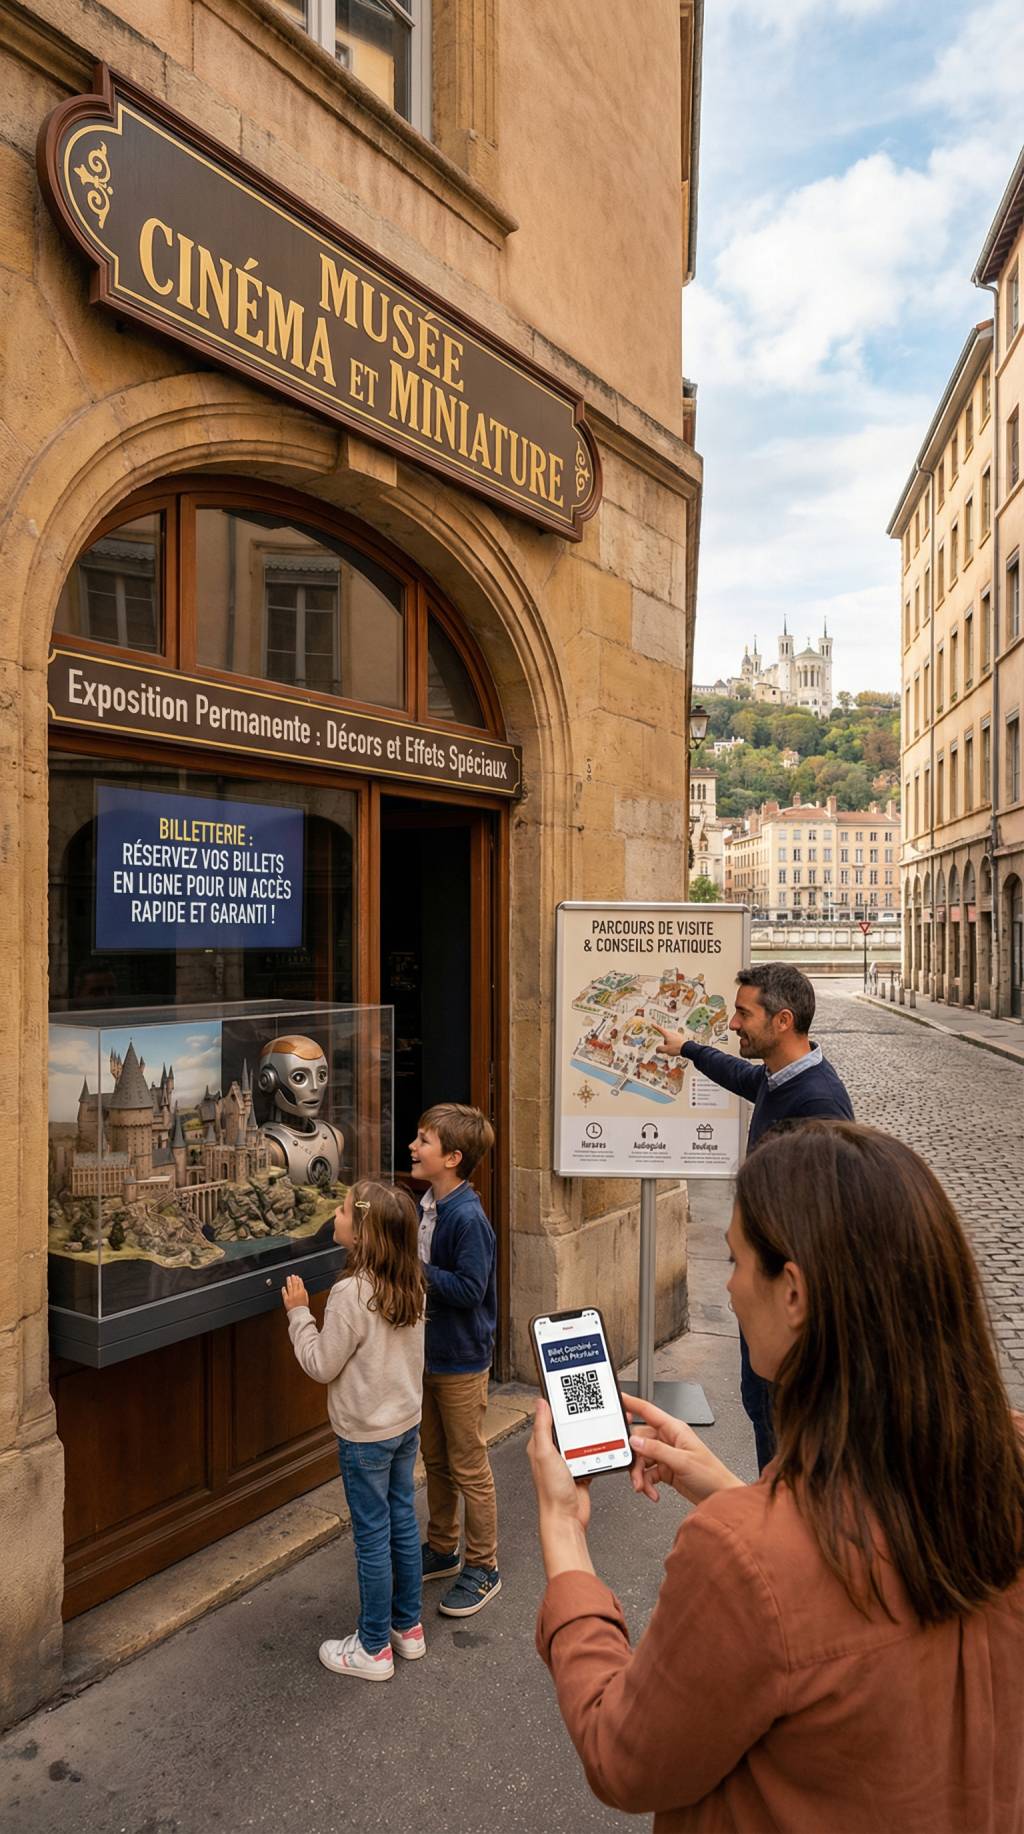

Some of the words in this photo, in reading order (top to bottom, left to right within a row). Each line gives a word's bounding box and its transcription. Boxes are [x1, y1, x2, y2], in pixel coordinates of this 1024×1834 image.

[319, 252, 465, 393] MUSÉE
[139, 217, 337, 388] CINÉMA
[349, 357, 379, 407] ET
[388, 359, 564, 508] MINIATURE
[68, 668, 188, 723] Exposition
[196, 693, 311, 744] Permanente
[315, 731, 321, 747] :
[326, 720, 383, 757] Décors
[386, 737, 402, 761] et
[405, 736, 445, 769] Effets
[449, 745, 508, 779] Spéciaux
[159, 817, 246, 846] BILLETTERIE
[122, 838, 198, 869] RÉSERVEZ
[201, 848, 229, 871] VOS
[233, 851, 285, 874] BILLETS
[113, 871, 134, 894] EN
[138, 872, 183, 896] LIGNE
[187, 874, 225, 897] POUR
[228, 876, 247, 898] UN
[250, 874, 292, 900] ACCÈS
[131, 900, 186, 923] RAPIDE
[190, 902, 207, 924] ET
[210, 903, 267, 924] GARANTI
[271, 904, 276, 924] !
[591, 920, 655, 935] PARCOURS
[658, 920, 673, 935] DE
[677, 921, 714, 936] VISITE
[583, 939, 592, 952] &
[596, 938, 654, 953] CONSEILS
[657, 939, 722, 954] PRATIQUES
